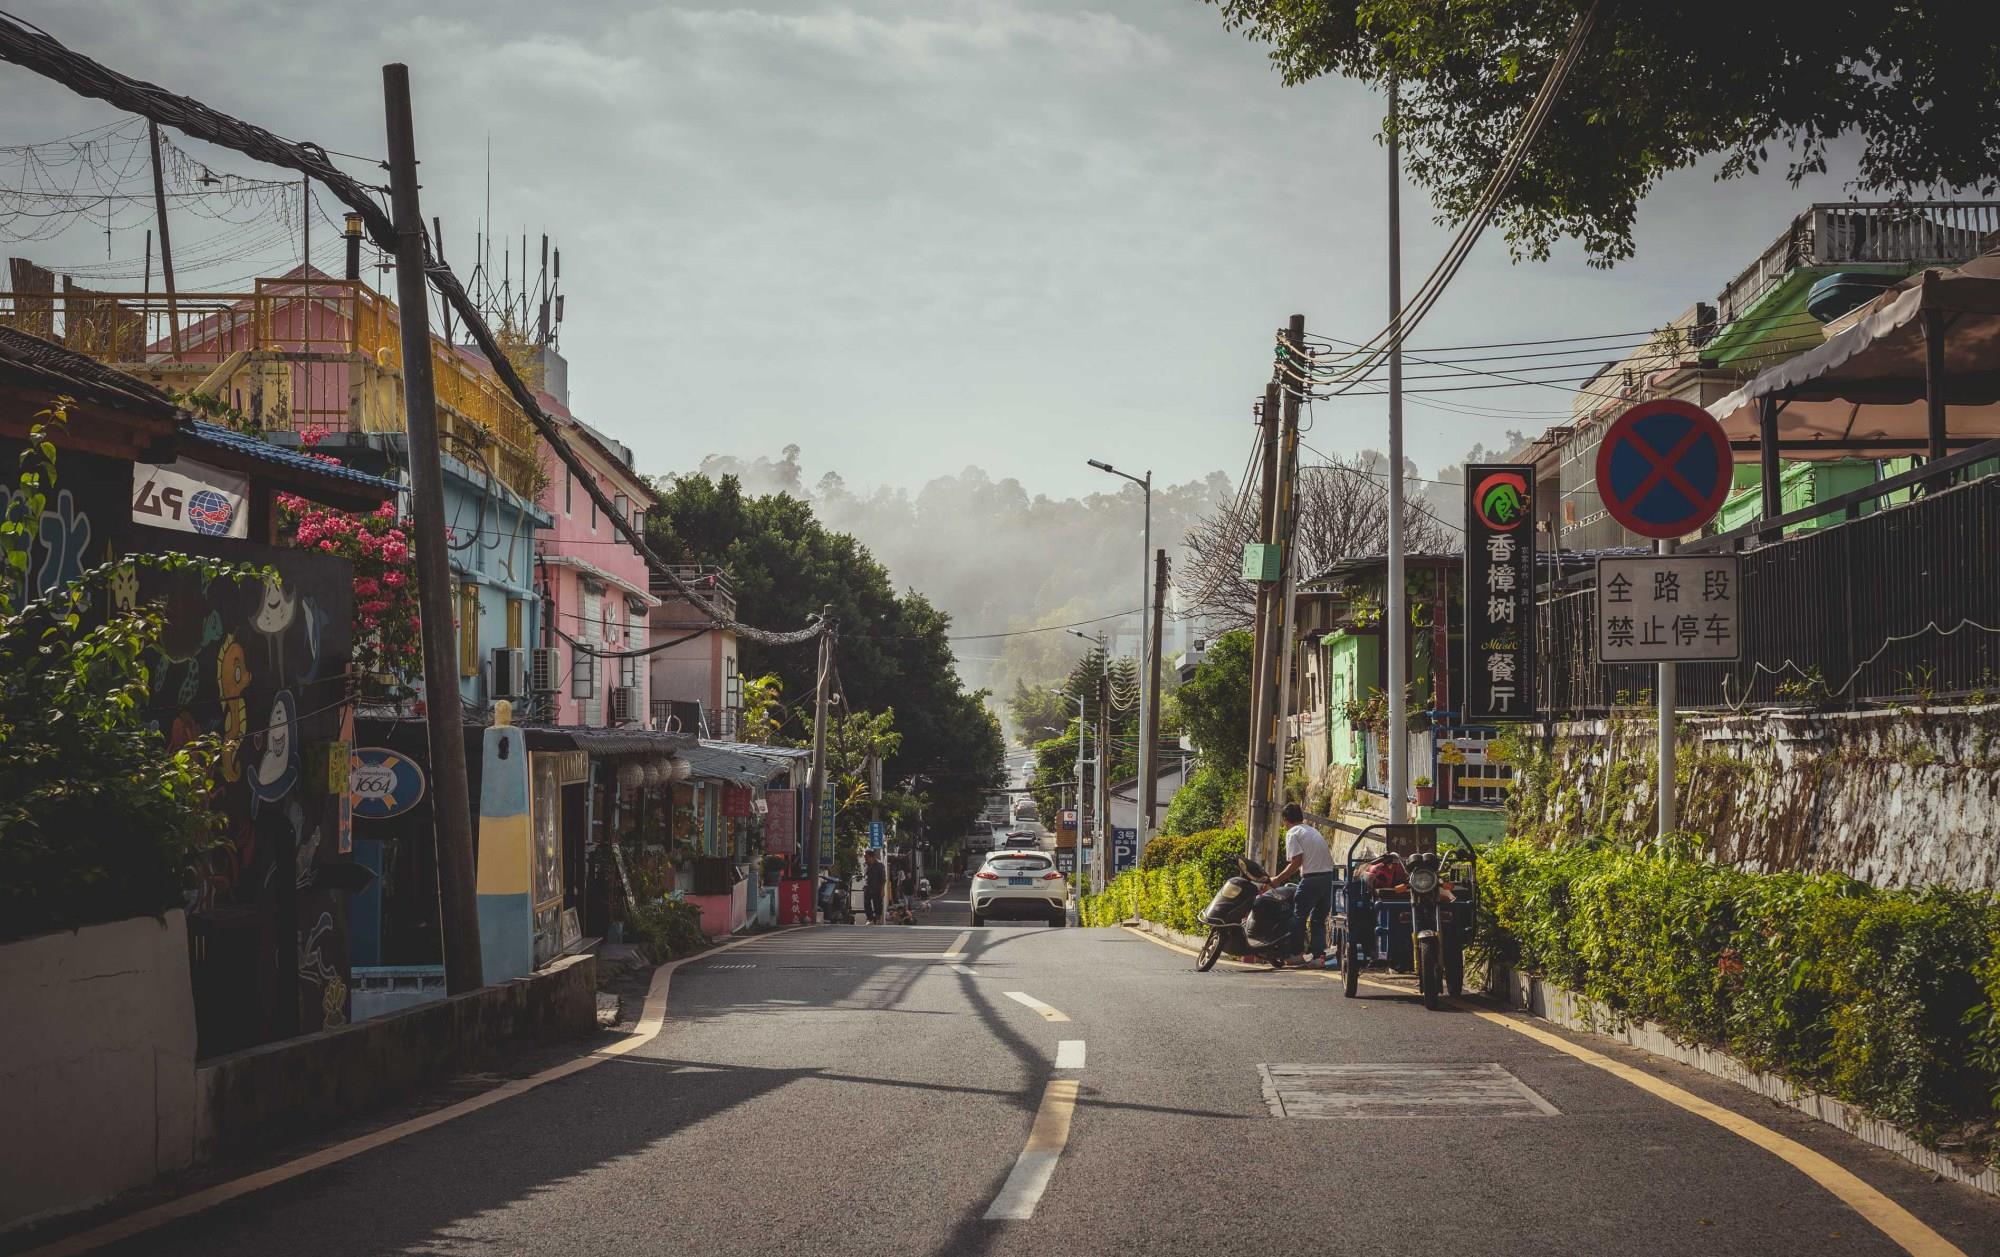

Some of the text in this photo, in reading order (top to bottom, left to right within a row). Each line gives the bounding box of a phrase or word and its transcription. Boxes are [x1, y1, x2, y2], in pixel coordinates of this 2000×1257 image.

[1486, 533, 1516, 623] 香樟树
[1607, 570, 1730, 603] 全路段
[1606, 614, 1731, 647] 禁止停车
[1486, 652, 1516, 712] 餐厅
[356, 777, 391, 793] 1664
[1115, 846, 1131, 864] P
